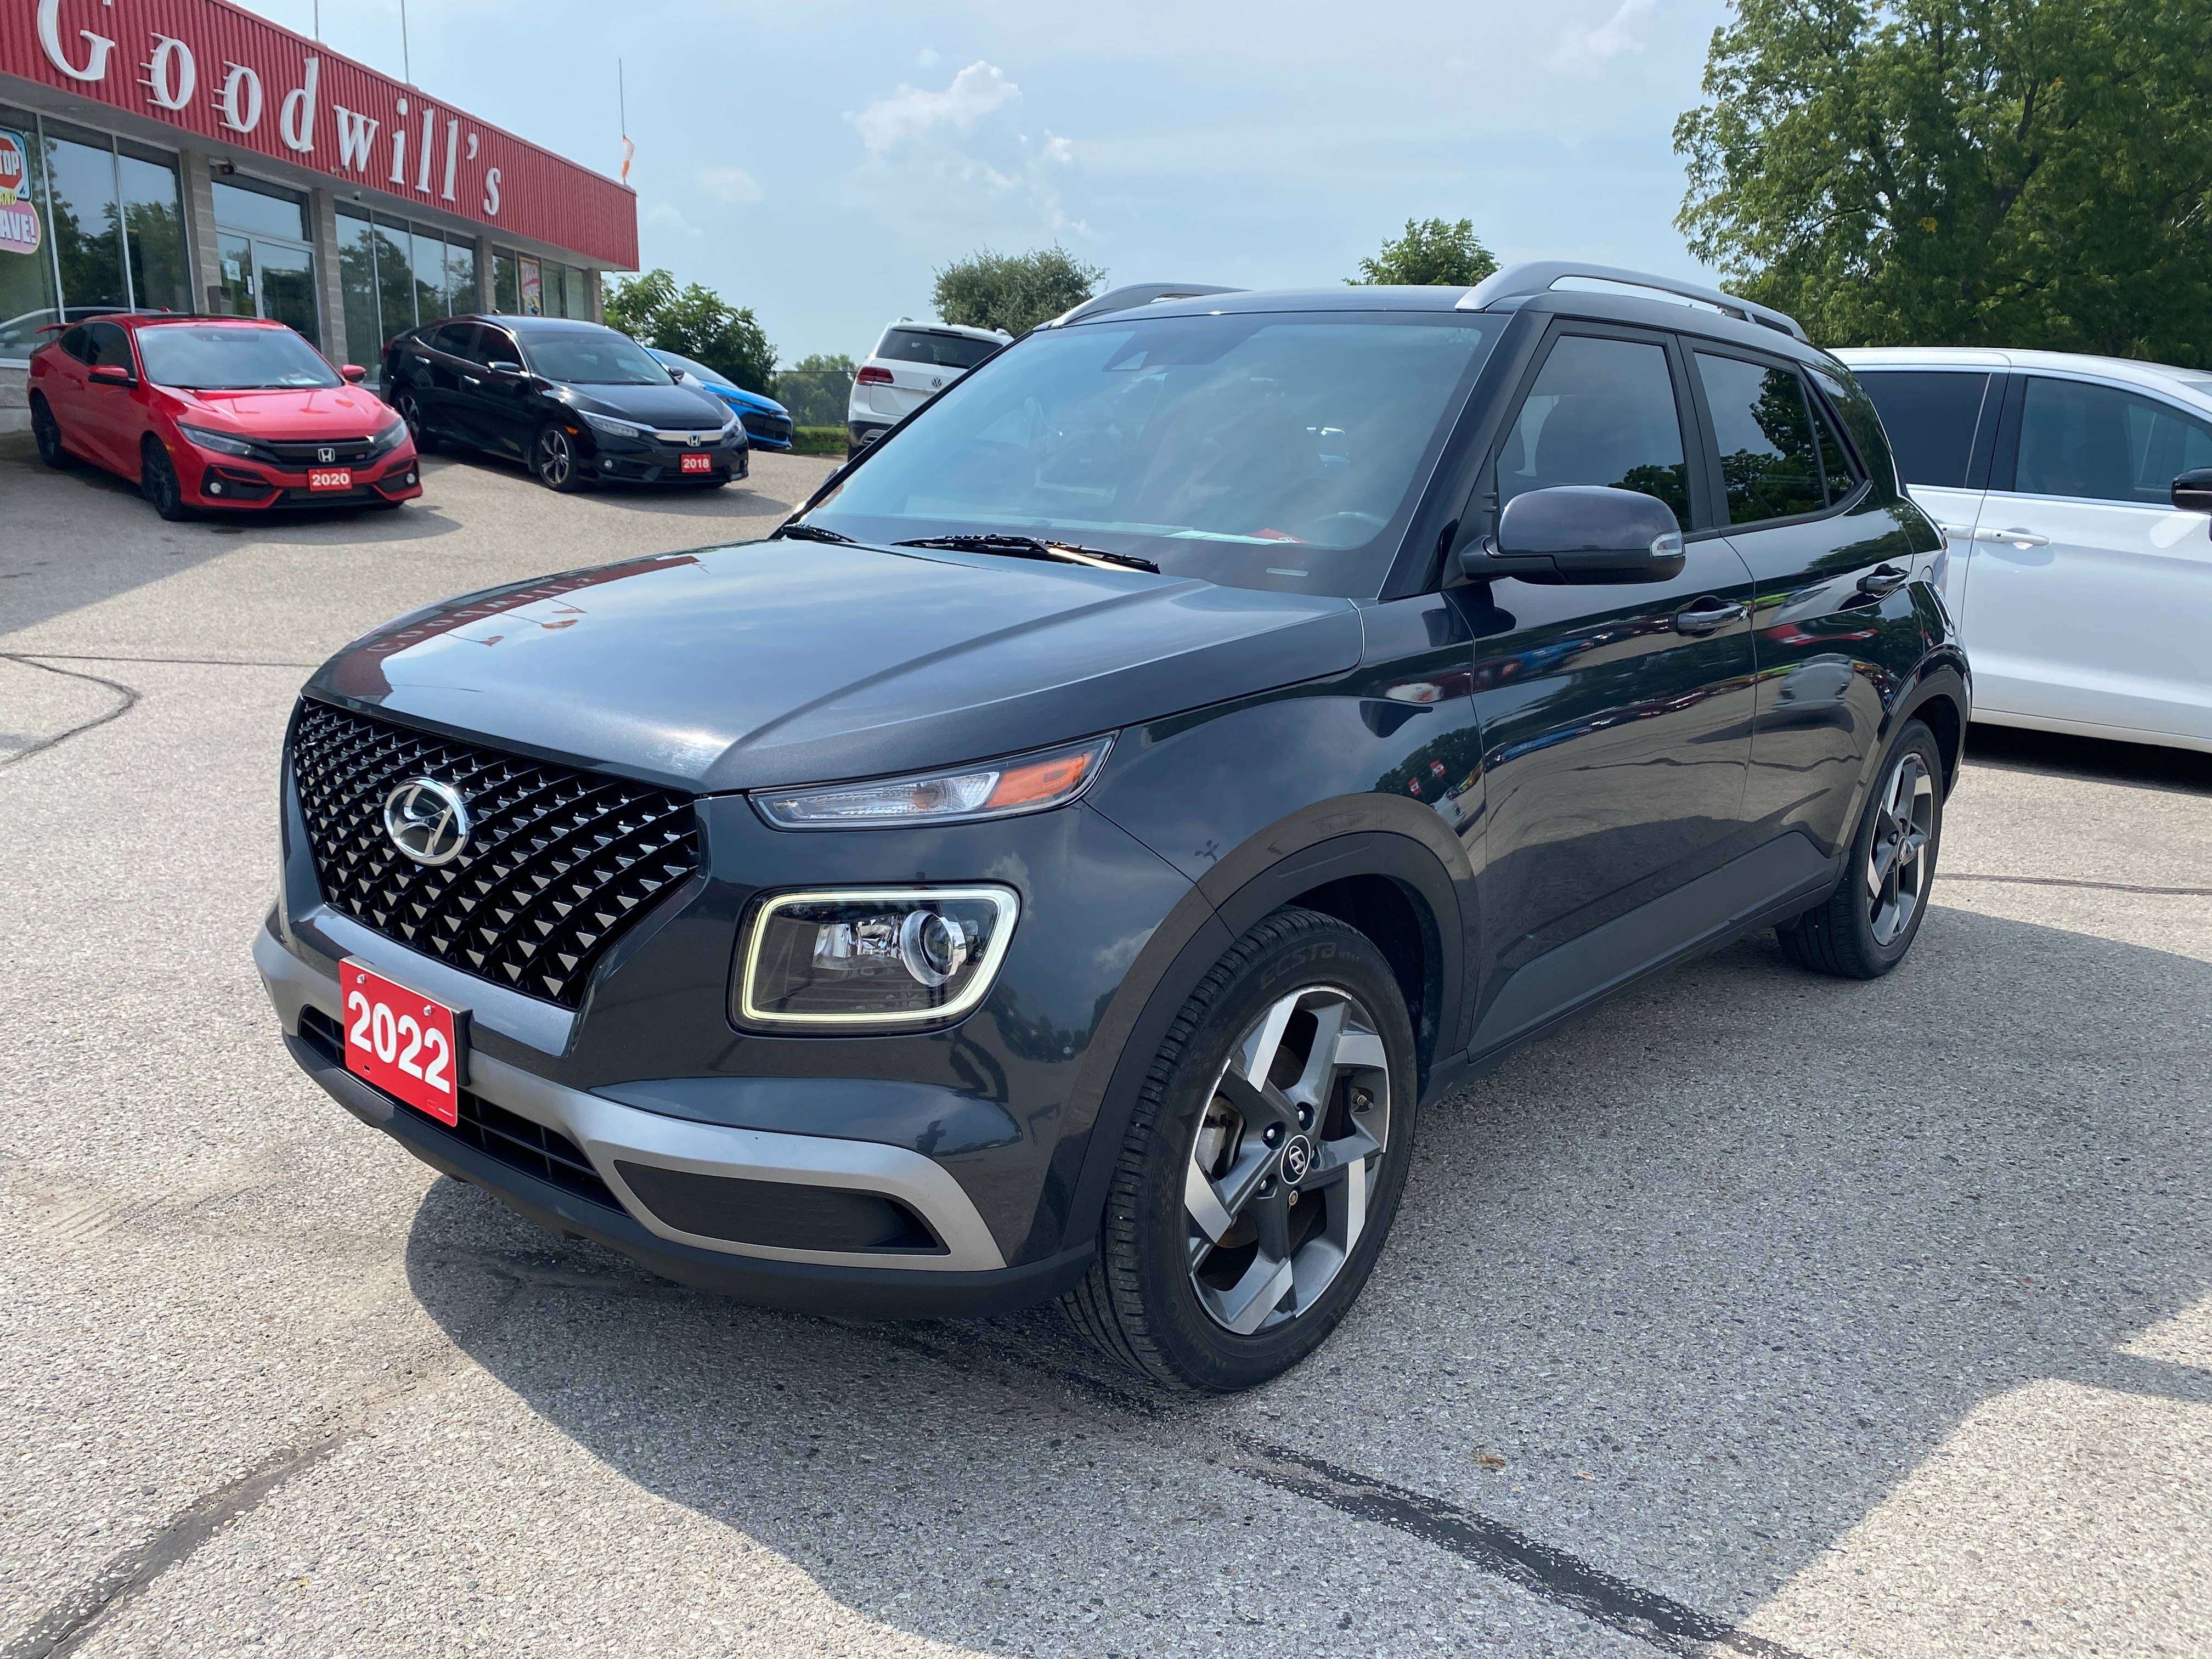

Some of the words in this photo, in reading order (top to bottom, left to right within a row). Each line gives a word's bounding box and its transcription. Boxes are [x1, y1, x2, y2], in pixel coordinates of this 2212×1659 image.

[37, 0, 501, 216] Goodwill's
[0, 210, 36, 244] AVE!
[312, 472, 349, 487] 2020
[684, 458, 709, 469] 2018
[348, 990, 450, 1094] 2022
